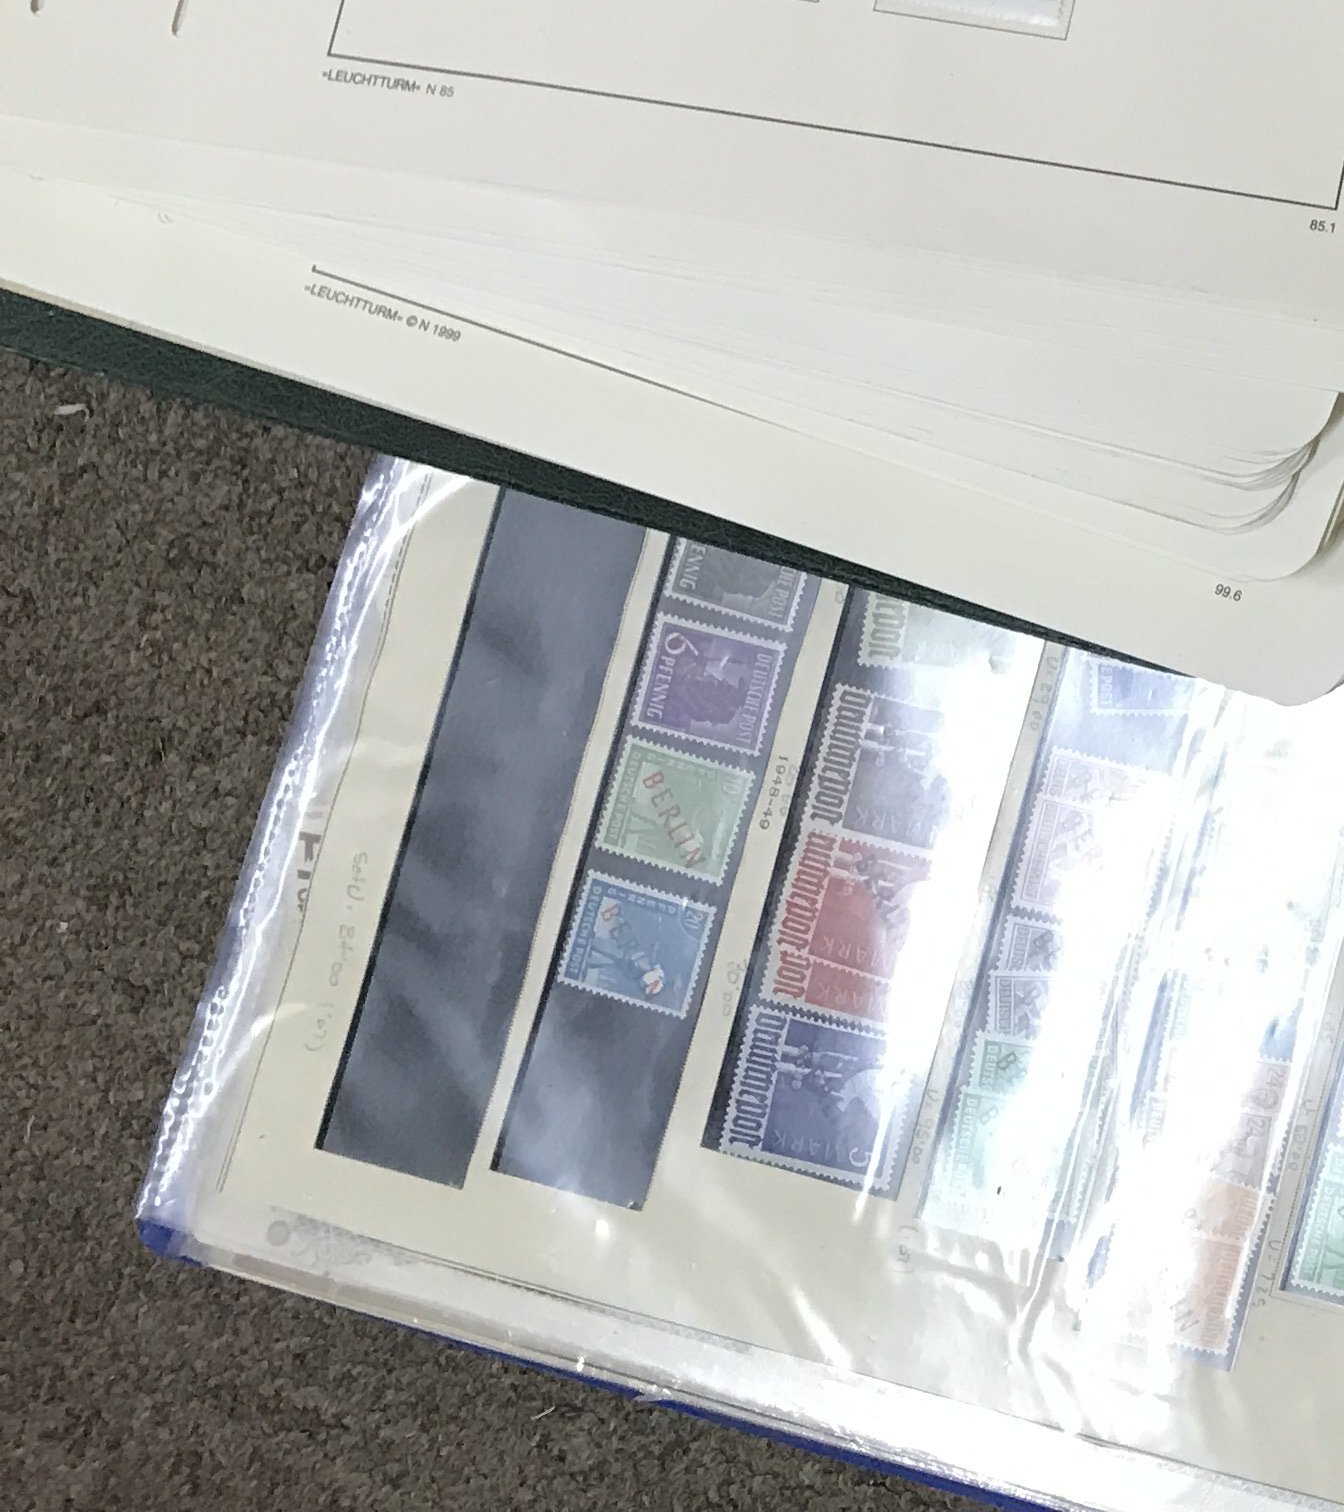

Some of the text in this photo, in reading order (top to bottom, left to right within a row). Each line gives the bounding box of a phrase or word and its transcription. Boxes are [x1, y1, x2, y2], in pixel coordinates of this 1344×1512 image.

[425, 83, 437, 95] N
[439, 85, 455, 97] 85
[1309, 219, 1336, 233] 85.1
[418, 319, 430, 332] N
[433, 324, 462, 342] 1999
[1214, 583, 1243, 602] 99.6
[664, 631, 699, 657] 6
[646, 656, 676, 721] PFENNIG
[744, 653, 773, 710] DEUTSCHE
[760, 755, 789, 830] 1948-49
[643, 770, 706, 869] BERLIN
